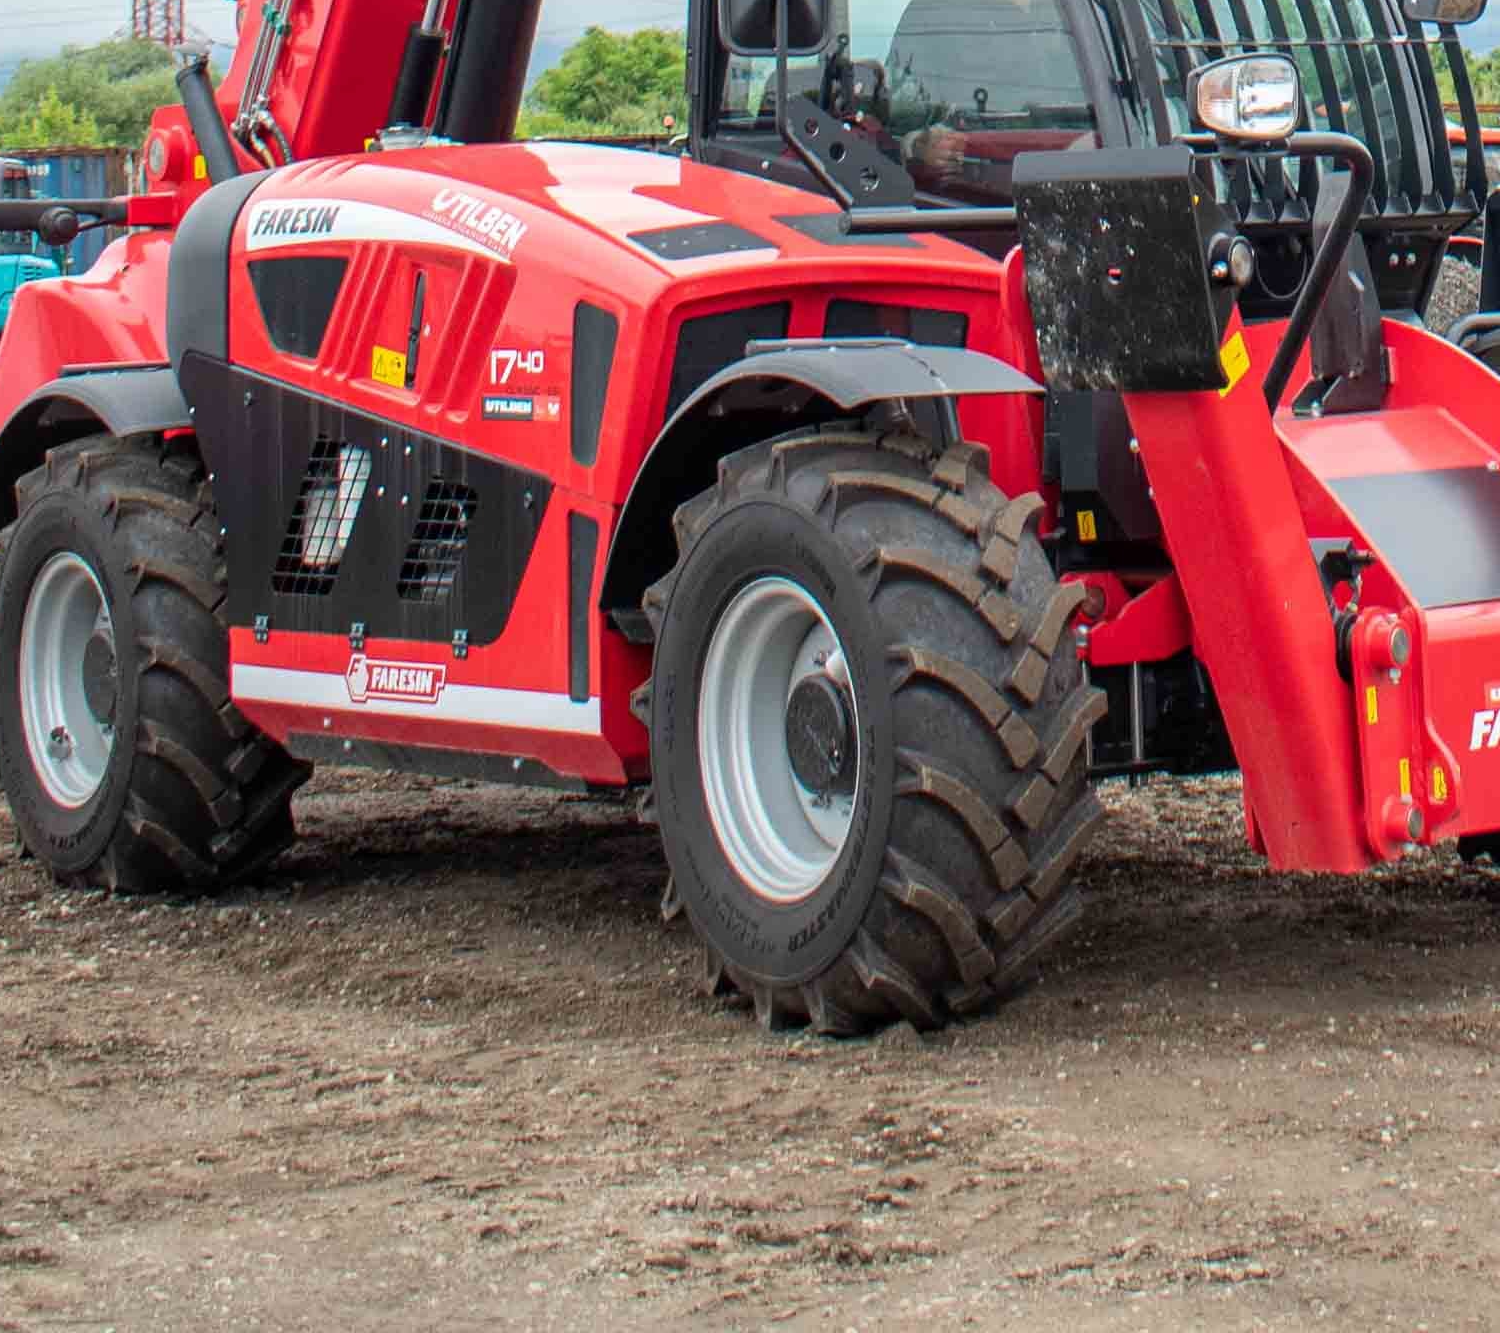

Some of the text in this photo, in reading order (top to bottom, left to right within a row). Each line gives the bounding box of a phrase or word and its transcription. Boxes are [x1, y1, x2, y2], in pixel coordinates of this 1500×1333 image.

[252, 206, 340, 236] FARESIN
[432, 189, 528, 250] UTILBEN
[371, 666, 435, 694] FARESIN
